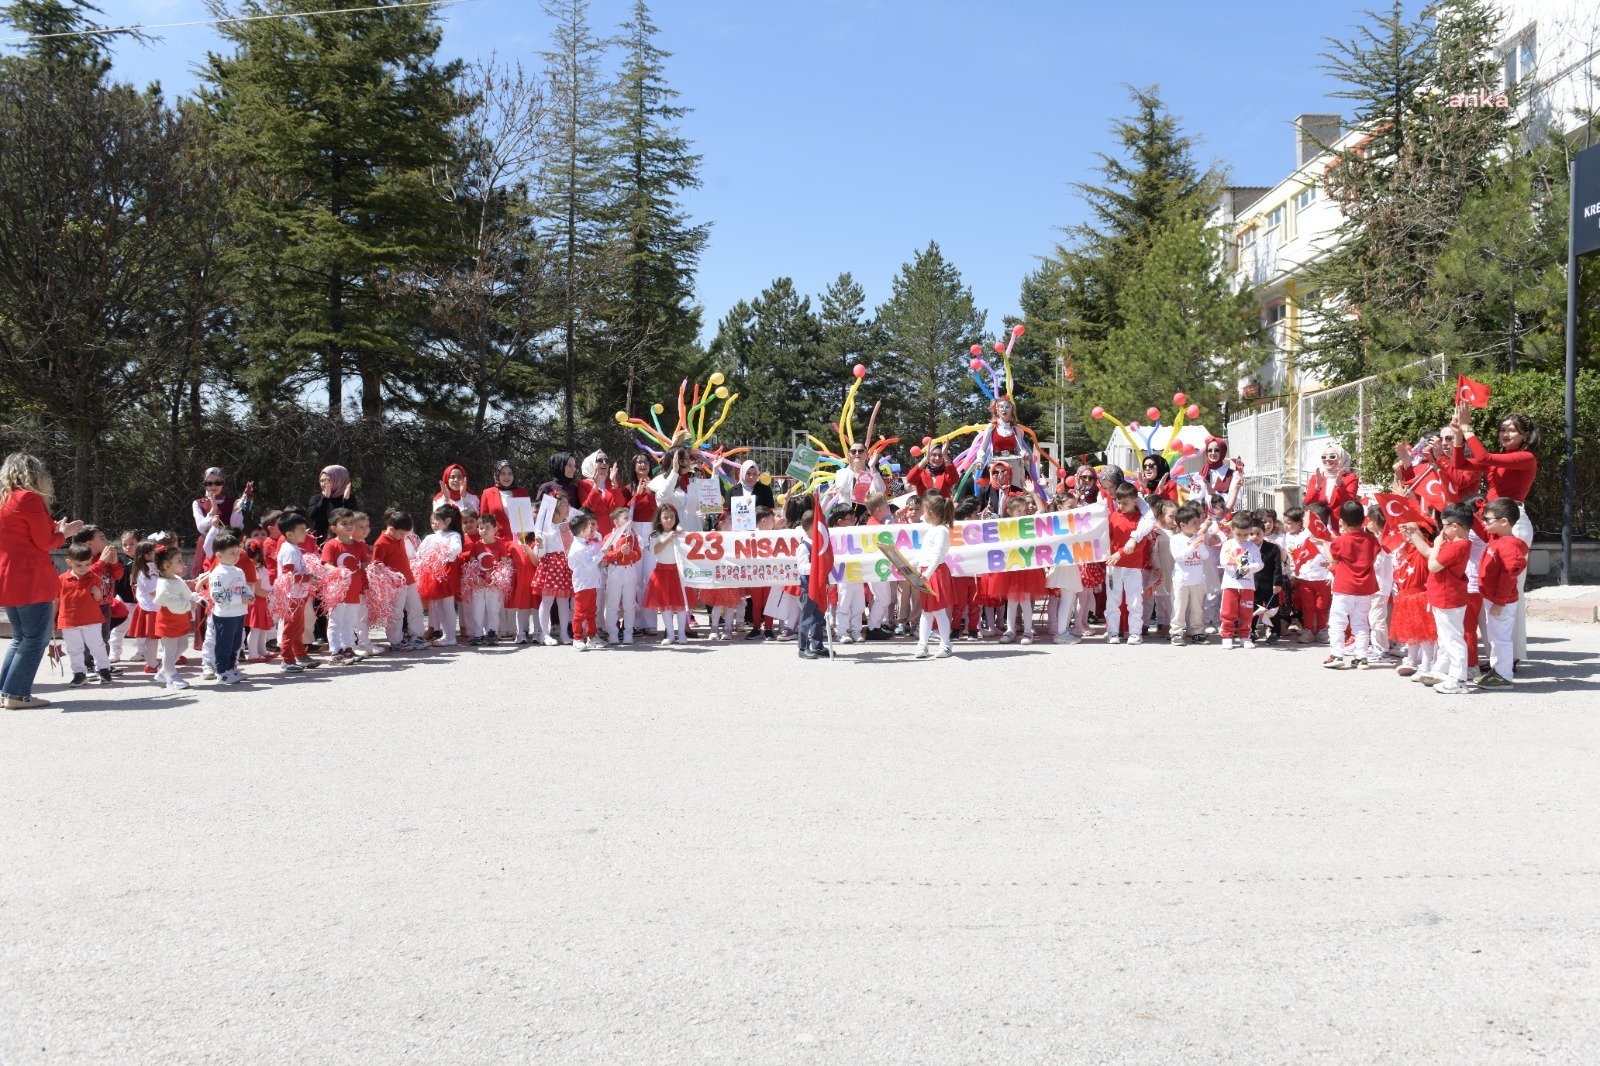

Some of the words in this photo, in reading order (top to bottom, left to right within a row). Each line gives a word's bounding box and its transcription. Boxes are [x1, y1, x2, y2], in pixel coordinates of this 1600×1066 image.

[684, 532, 725, 561] 23
[734, 532, 800, 560] NİSAN
[830, 528, 923, 556] ULUSAL
[831, 562, 863, 583] VE
[987, 539, 1102, 572] BAYRAMI
